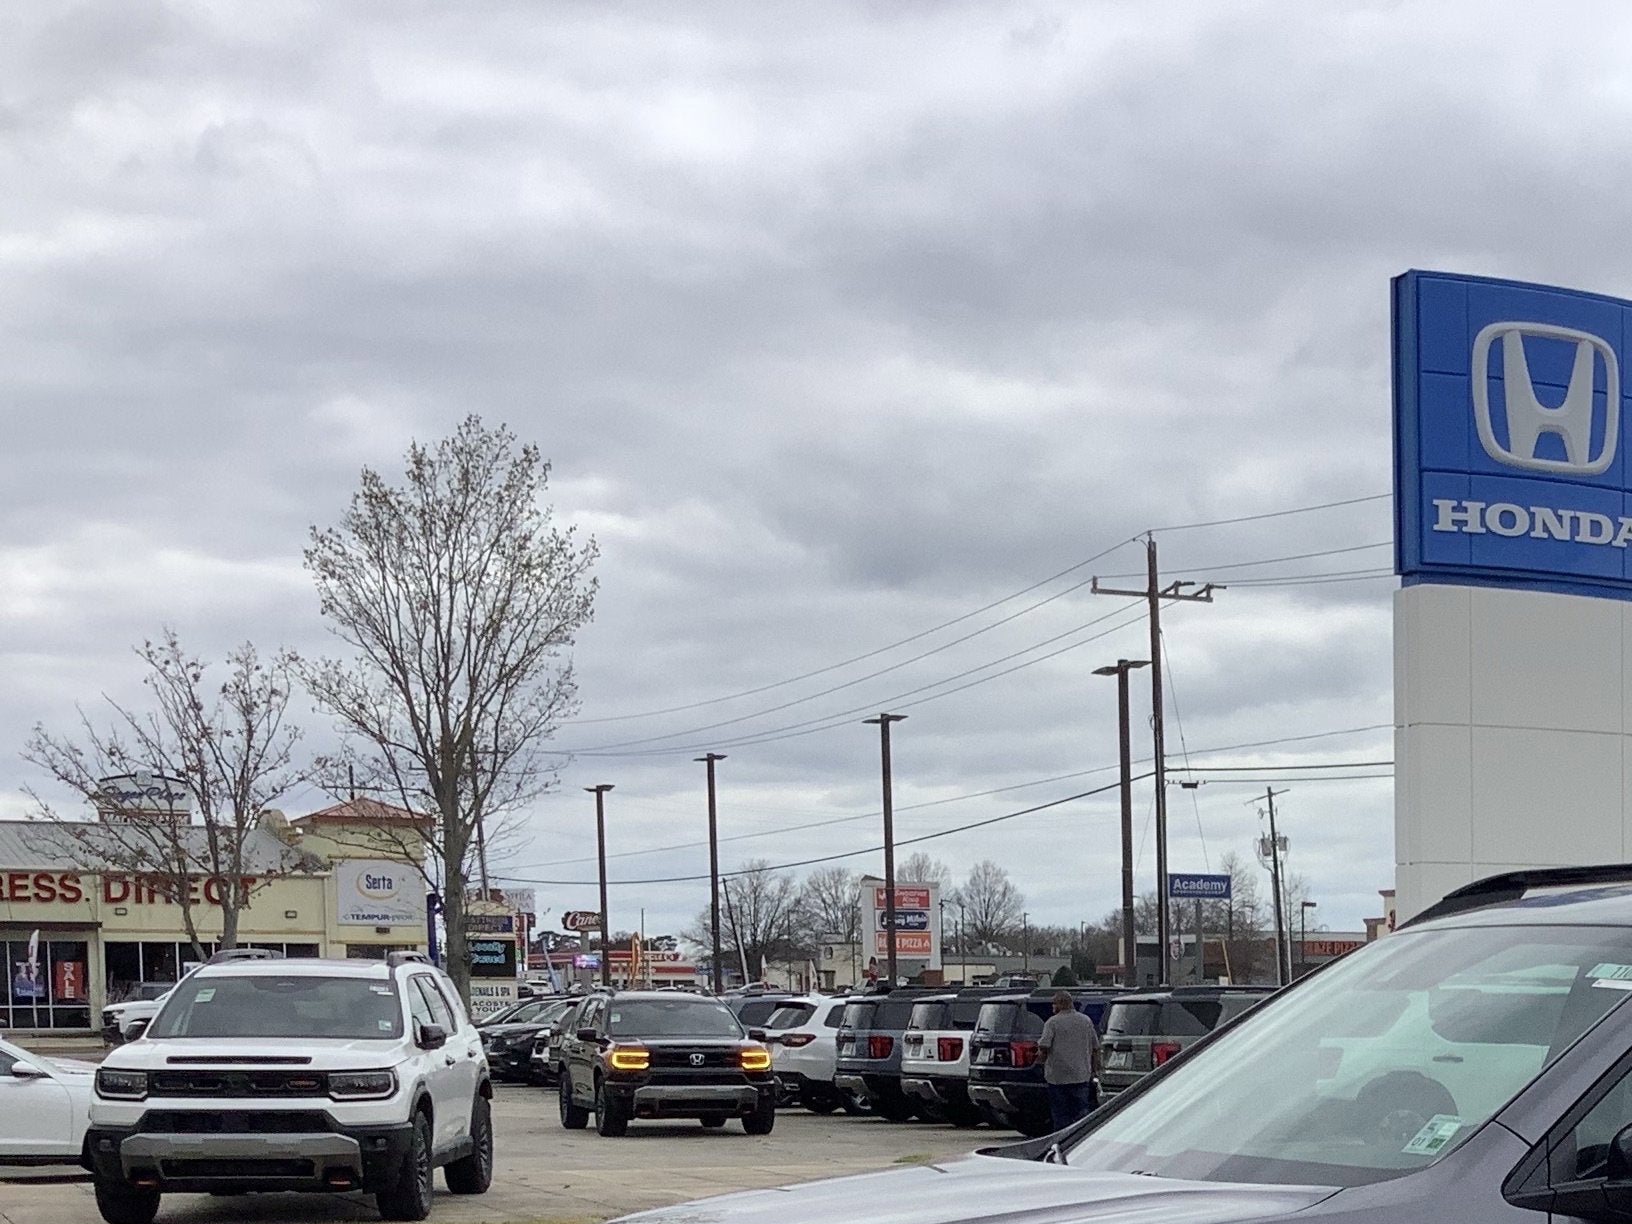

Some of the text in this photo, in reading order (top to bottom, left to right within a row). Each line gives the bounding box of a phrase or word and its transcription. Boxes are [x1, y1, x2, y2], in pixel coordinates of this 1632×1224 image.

[365, 874, 393, 890] Serta
[1172, 878, 1228, 893] Academy
[567, 911, 601, 929] Cane
[63, 962, 76, 998] SALE
